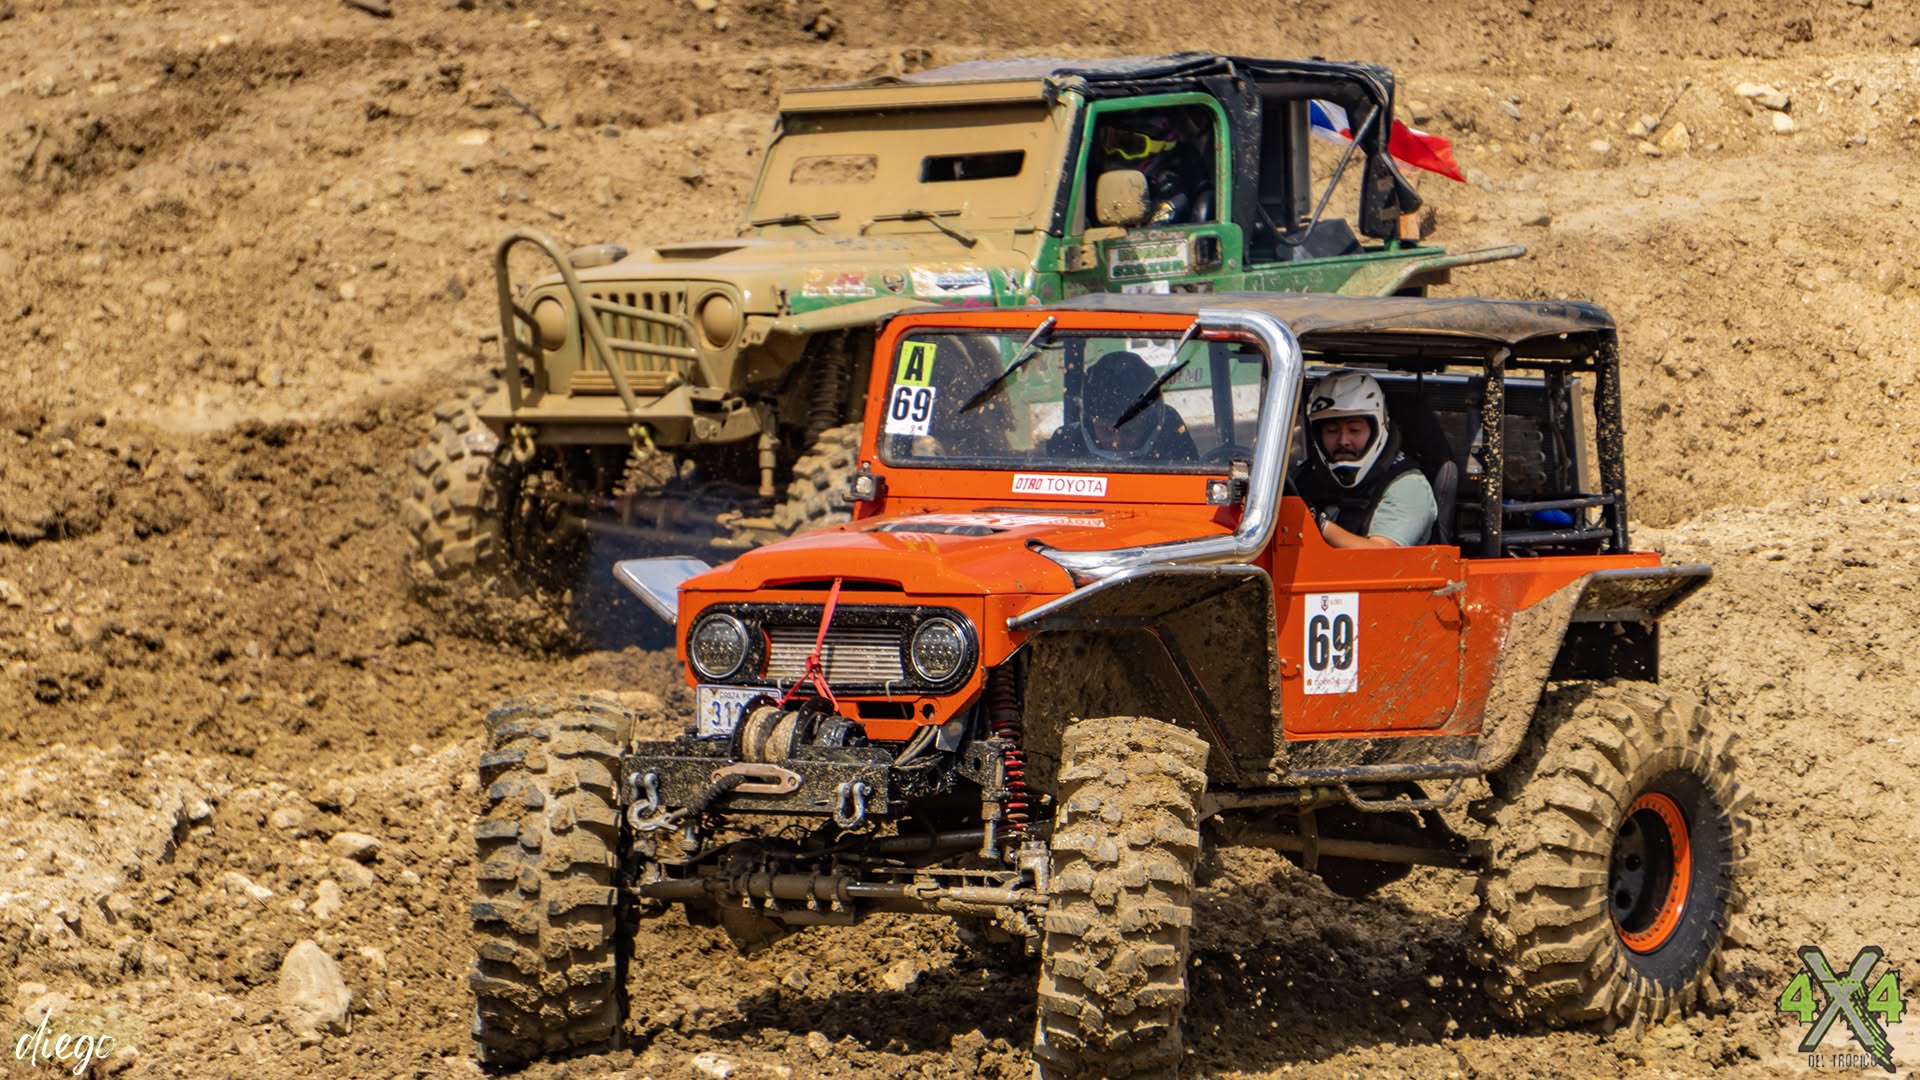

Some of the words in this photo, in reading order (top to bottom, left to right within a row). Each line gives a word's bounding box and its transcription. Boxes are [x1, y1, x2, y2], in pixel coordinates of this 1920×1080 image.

[903, 345, 925, 381] A
[892, 386, 932, 423] 69
[1046, 478, 1103, 493] TOYOTA
[1308, 613, 1354, 671] 69
